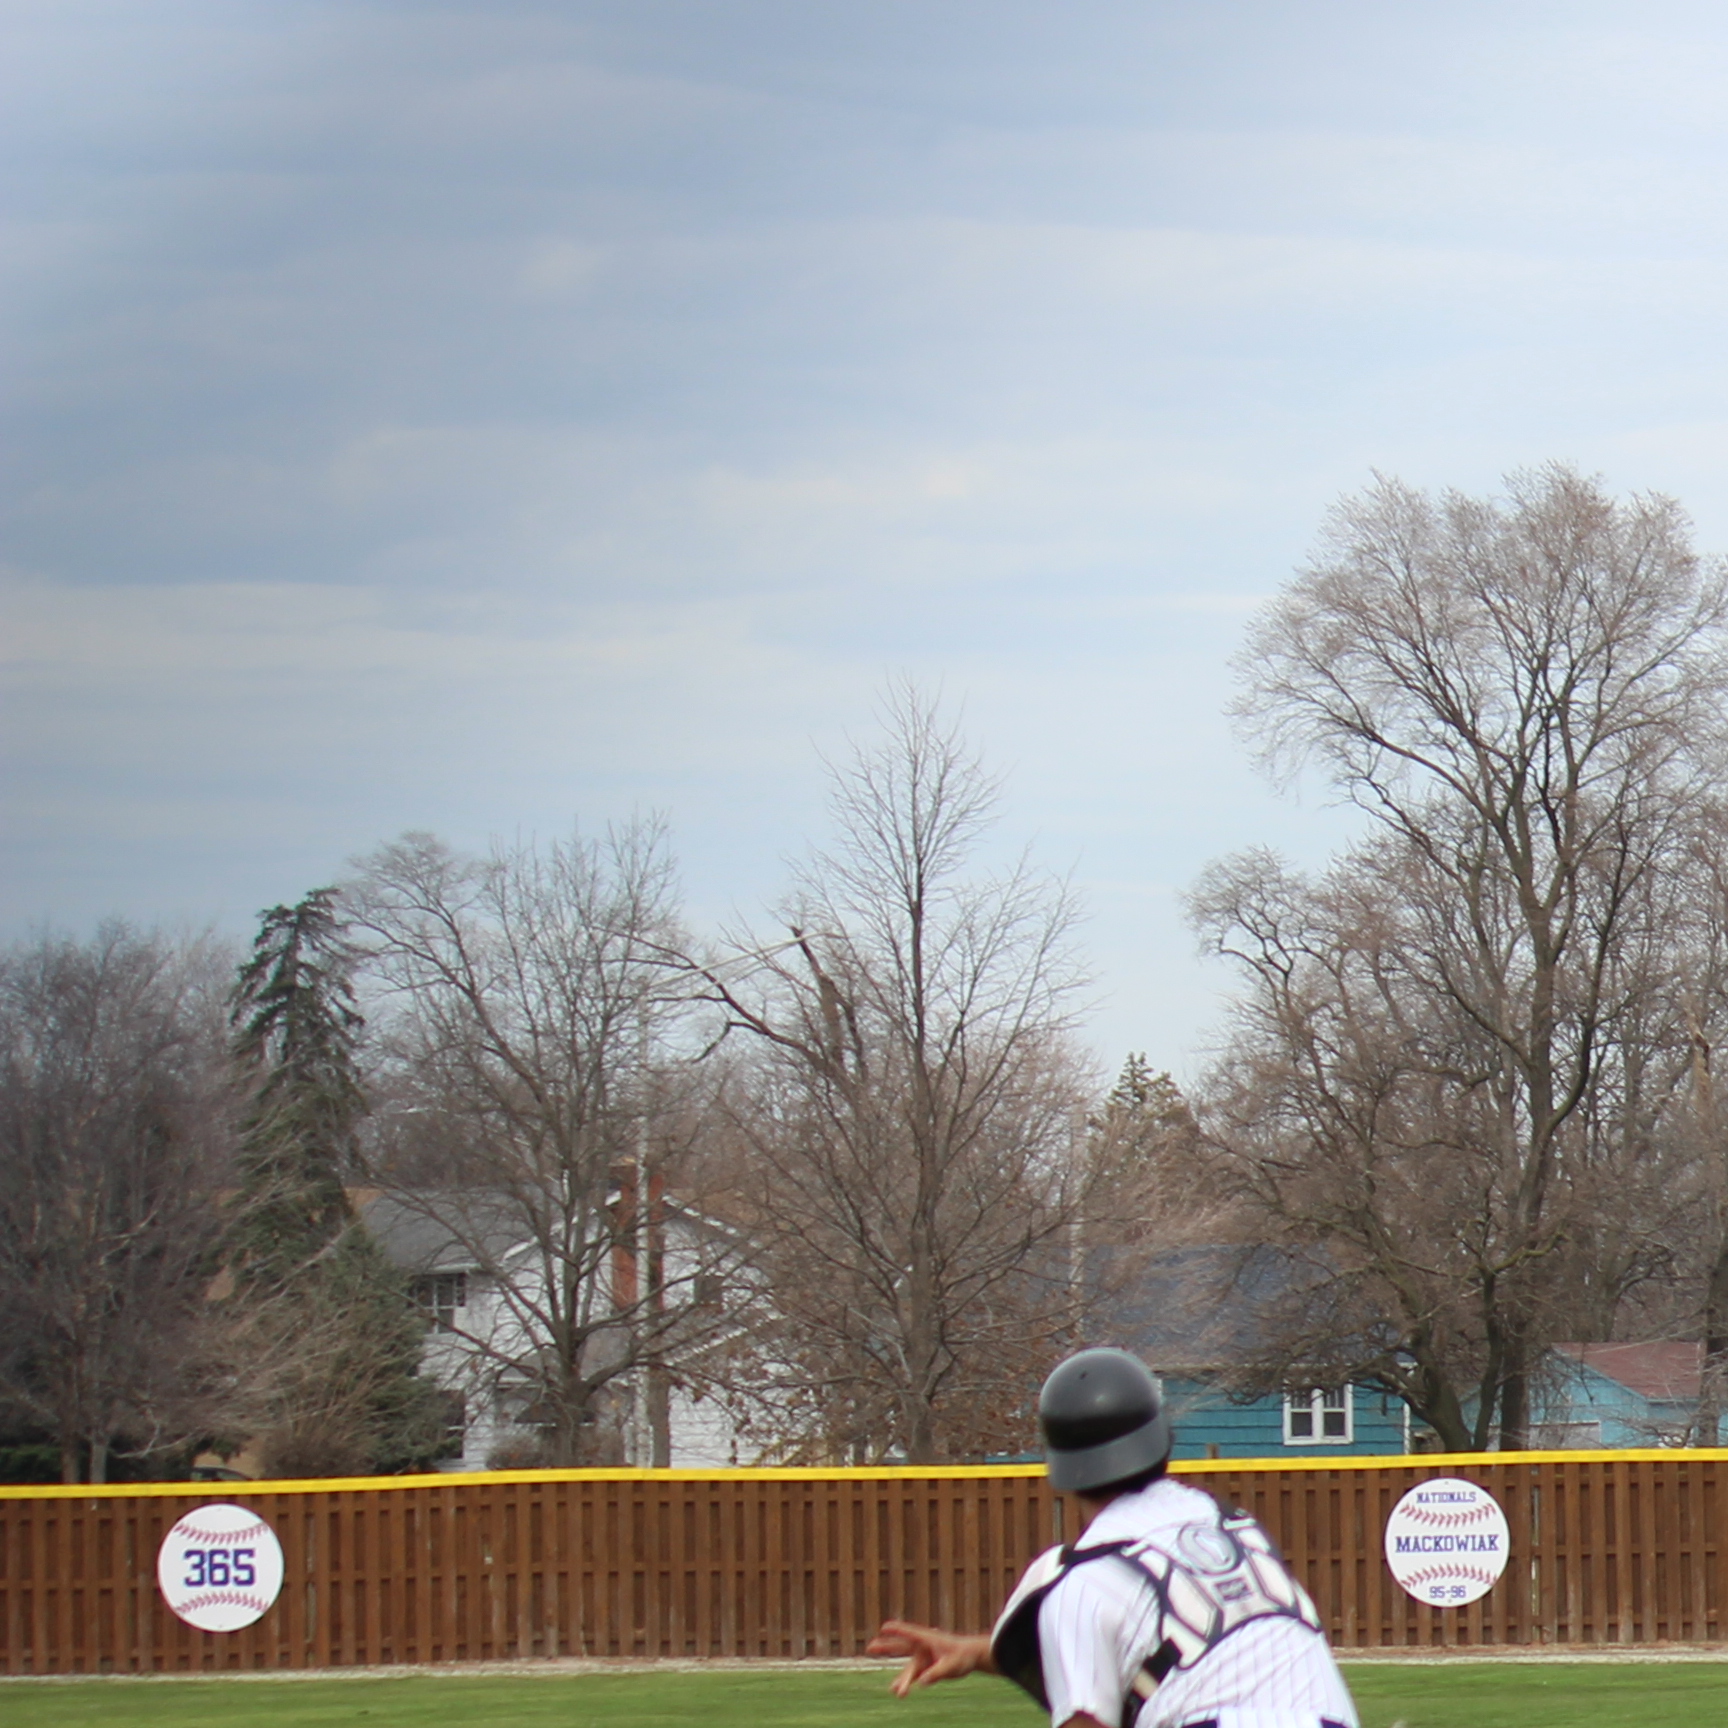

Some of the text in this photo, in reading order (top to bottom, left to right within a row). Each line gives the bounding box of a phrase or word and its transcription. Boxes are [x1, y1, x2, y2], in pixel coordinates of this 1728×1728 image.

[1416, 1491, 1477, 1504] NATIONALS
[1395, 1533, 1500, 1553] MACKOWIAK
[183, 1548, 256, 1587] 365
